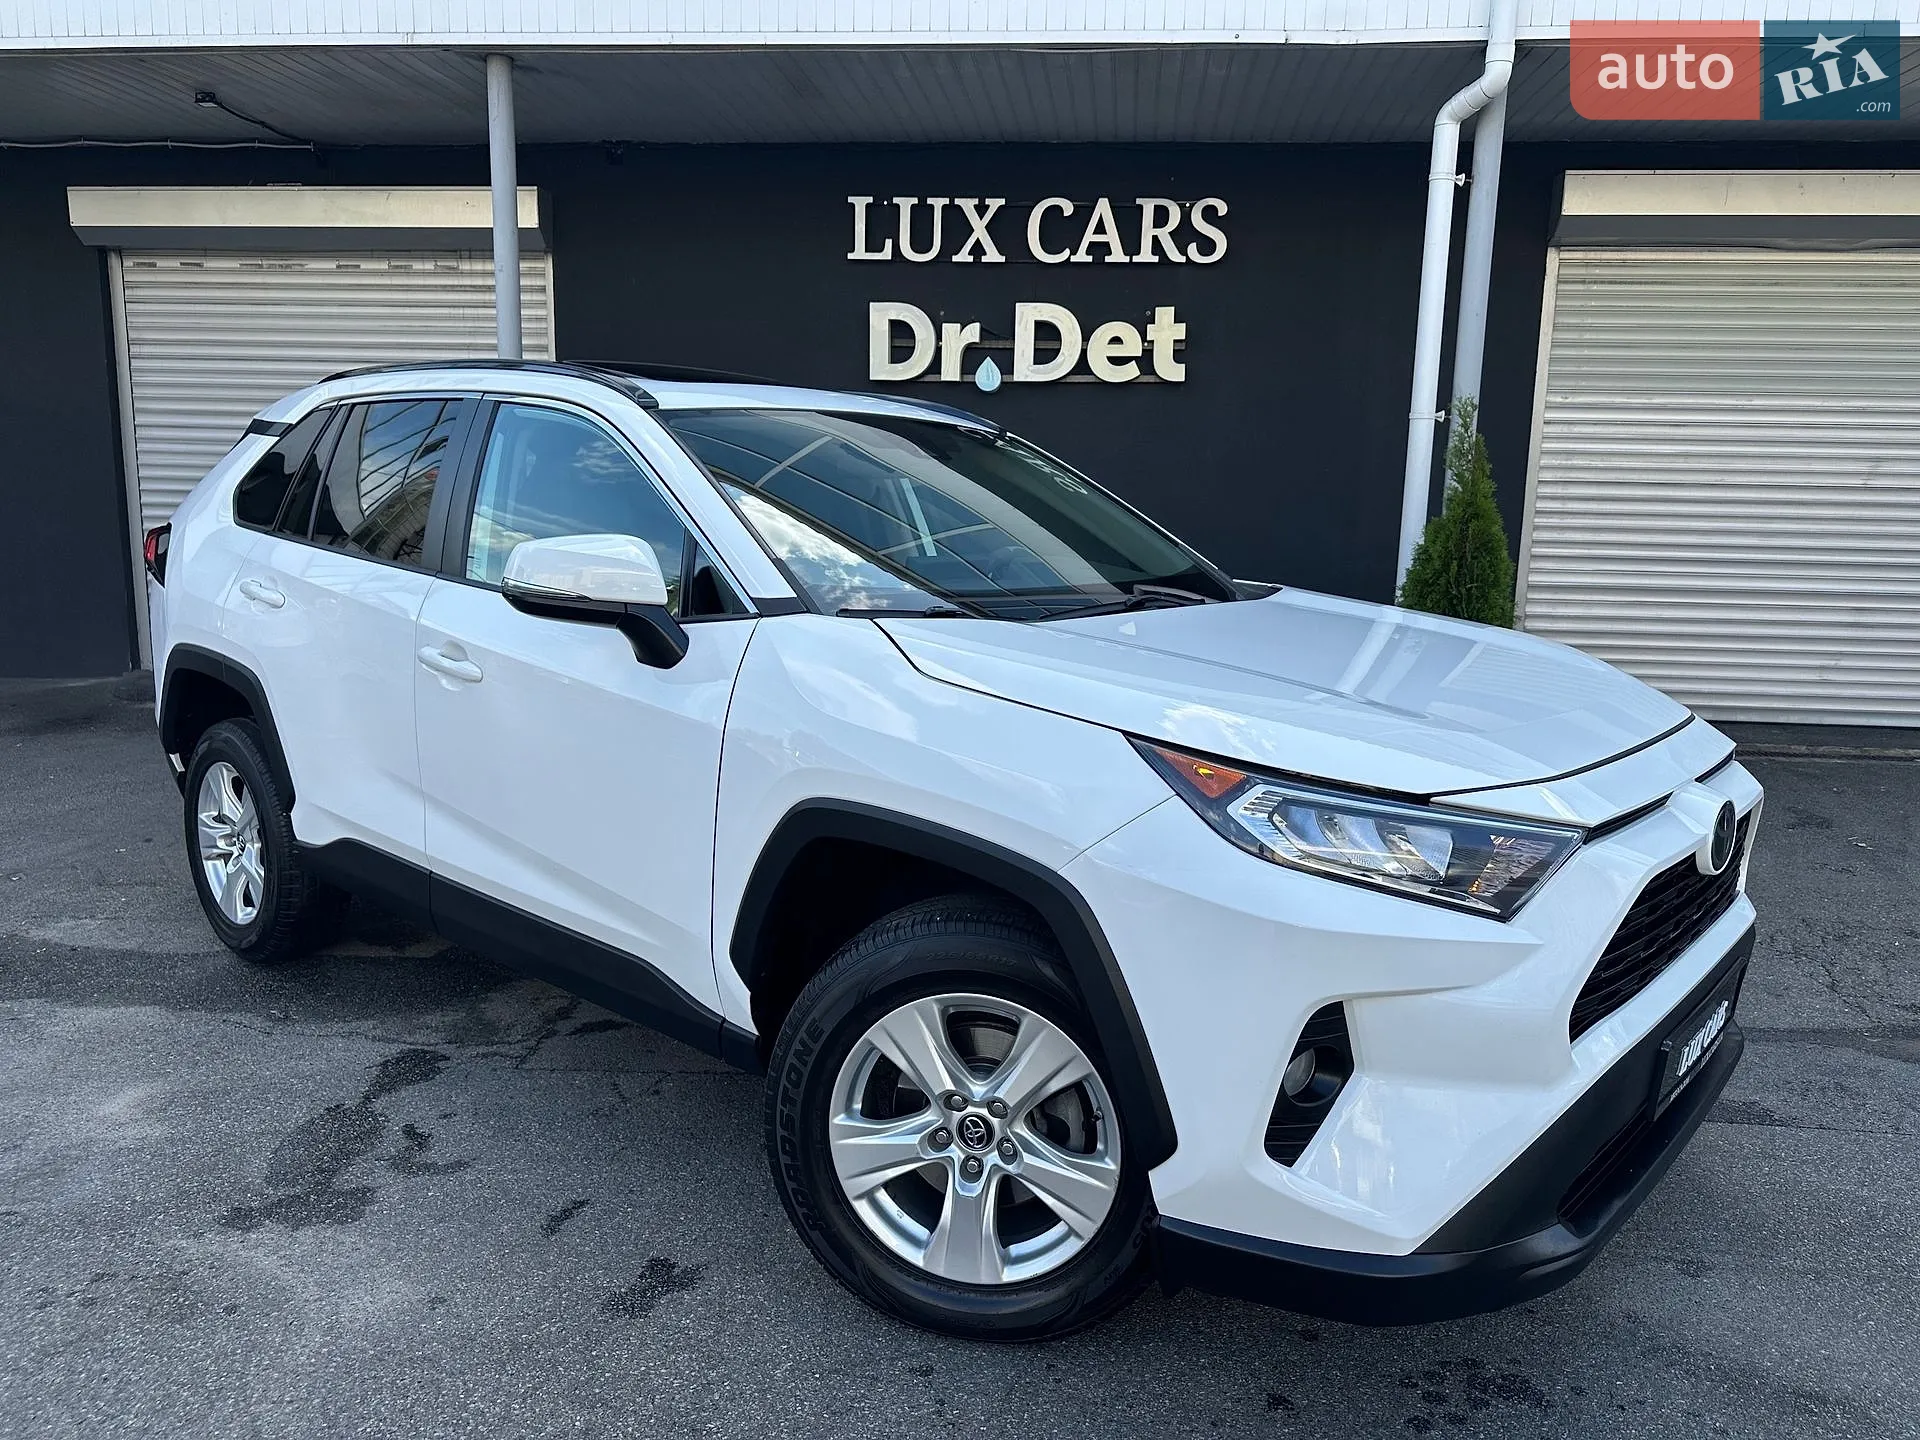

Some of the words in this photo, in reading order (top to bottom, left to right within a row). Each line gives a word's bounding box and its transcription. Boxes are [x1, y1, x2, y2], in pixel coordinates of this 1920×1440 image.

[847, 196, 1006, 263] LUX
[1027, 197, 1228, 264] CARS
[779, 1016, 826, 1232] ROADSTONE
